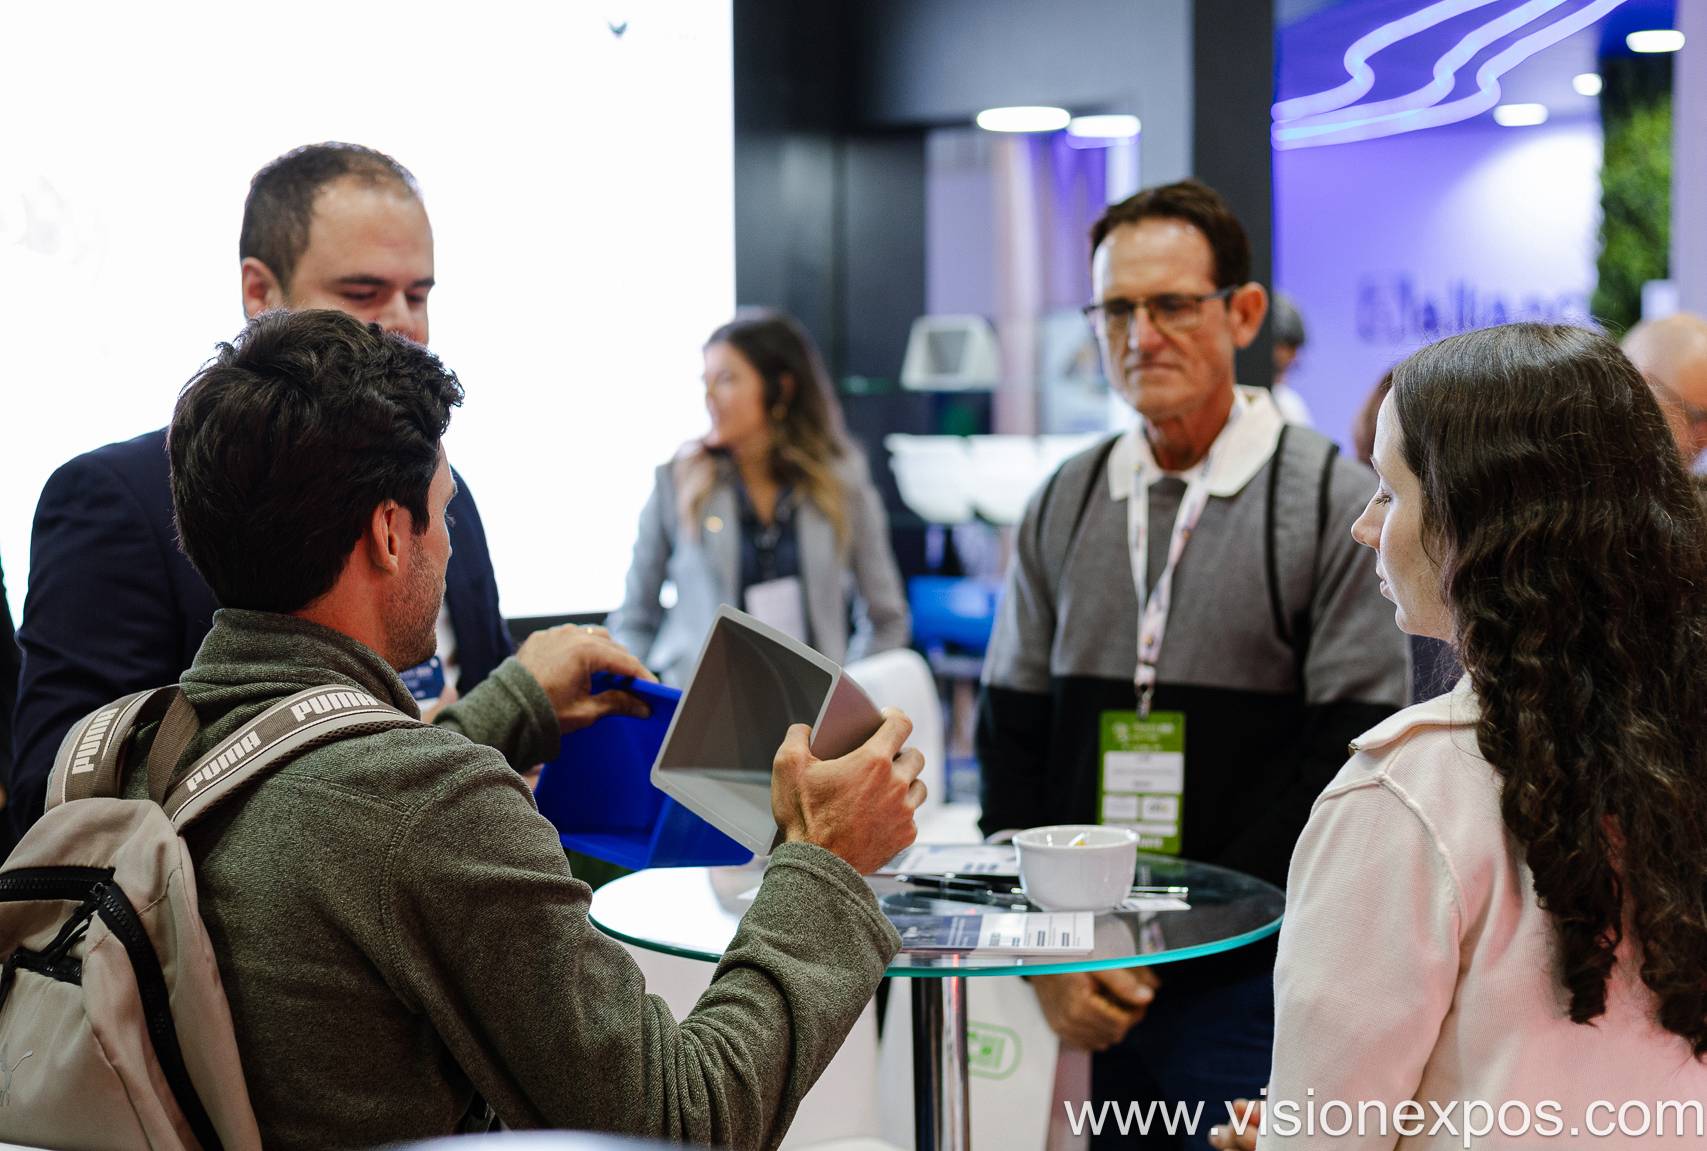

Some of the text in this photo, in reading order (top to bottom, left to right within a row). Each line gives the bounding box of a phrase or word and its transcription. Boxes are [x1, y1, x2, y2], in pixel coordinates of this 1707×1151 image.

[72, 707, 120, 775] PUMA
[185, 691, 379, 793] PUMA PUMA
